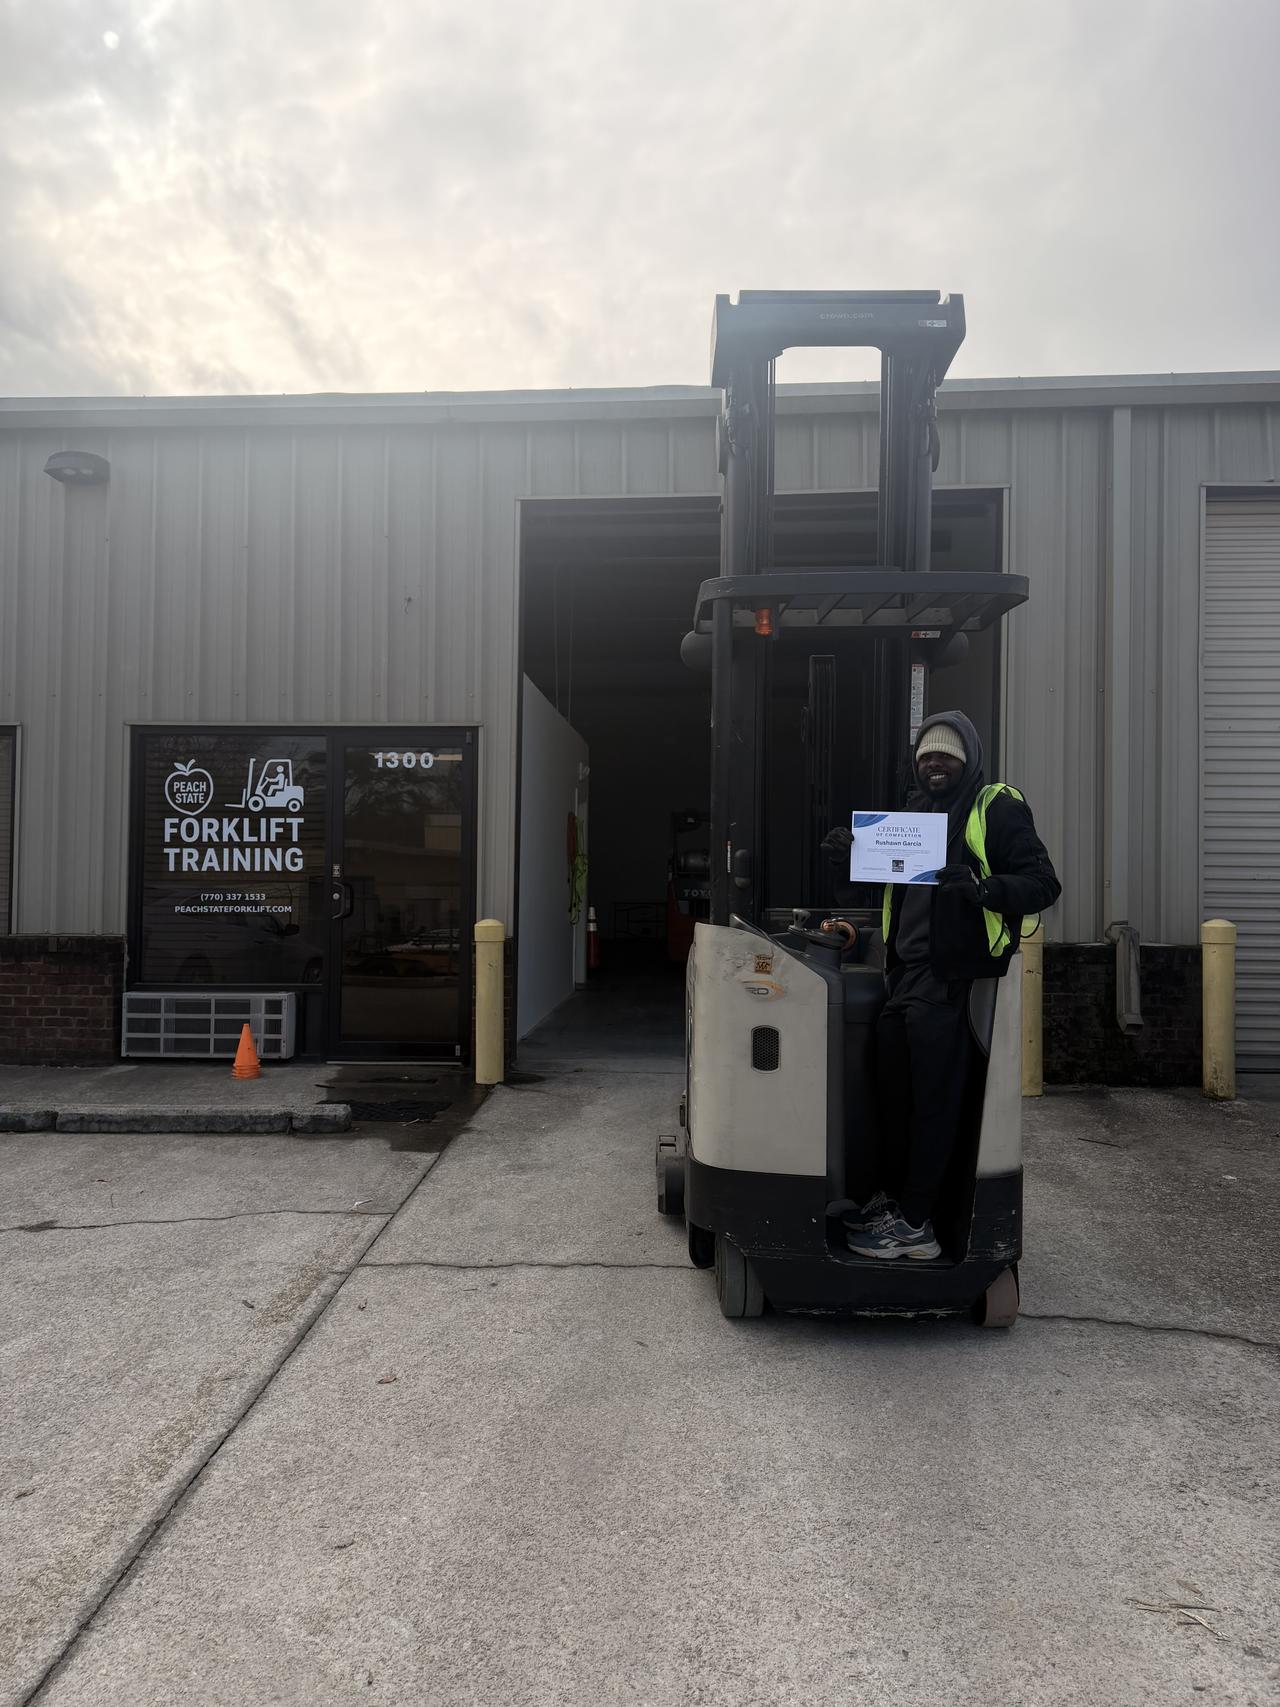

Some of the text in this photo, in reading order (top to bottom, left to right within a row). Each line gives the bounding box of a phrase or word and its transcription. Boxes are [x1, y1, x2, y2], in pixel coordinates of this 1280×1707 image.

[374, 751, 435, 769] 1300
[173, 781, 207, 793] PEACH
[175, 793, 205, 804] STATE
[164, 817, 304, 842] FORKLIFT
[164, 847, 304, 872] TRAINING
[200, 892, 266, 902] (770) 337 1533
[174, 905, 292, 913] PEACHSTATEFORKLIFT.COM
